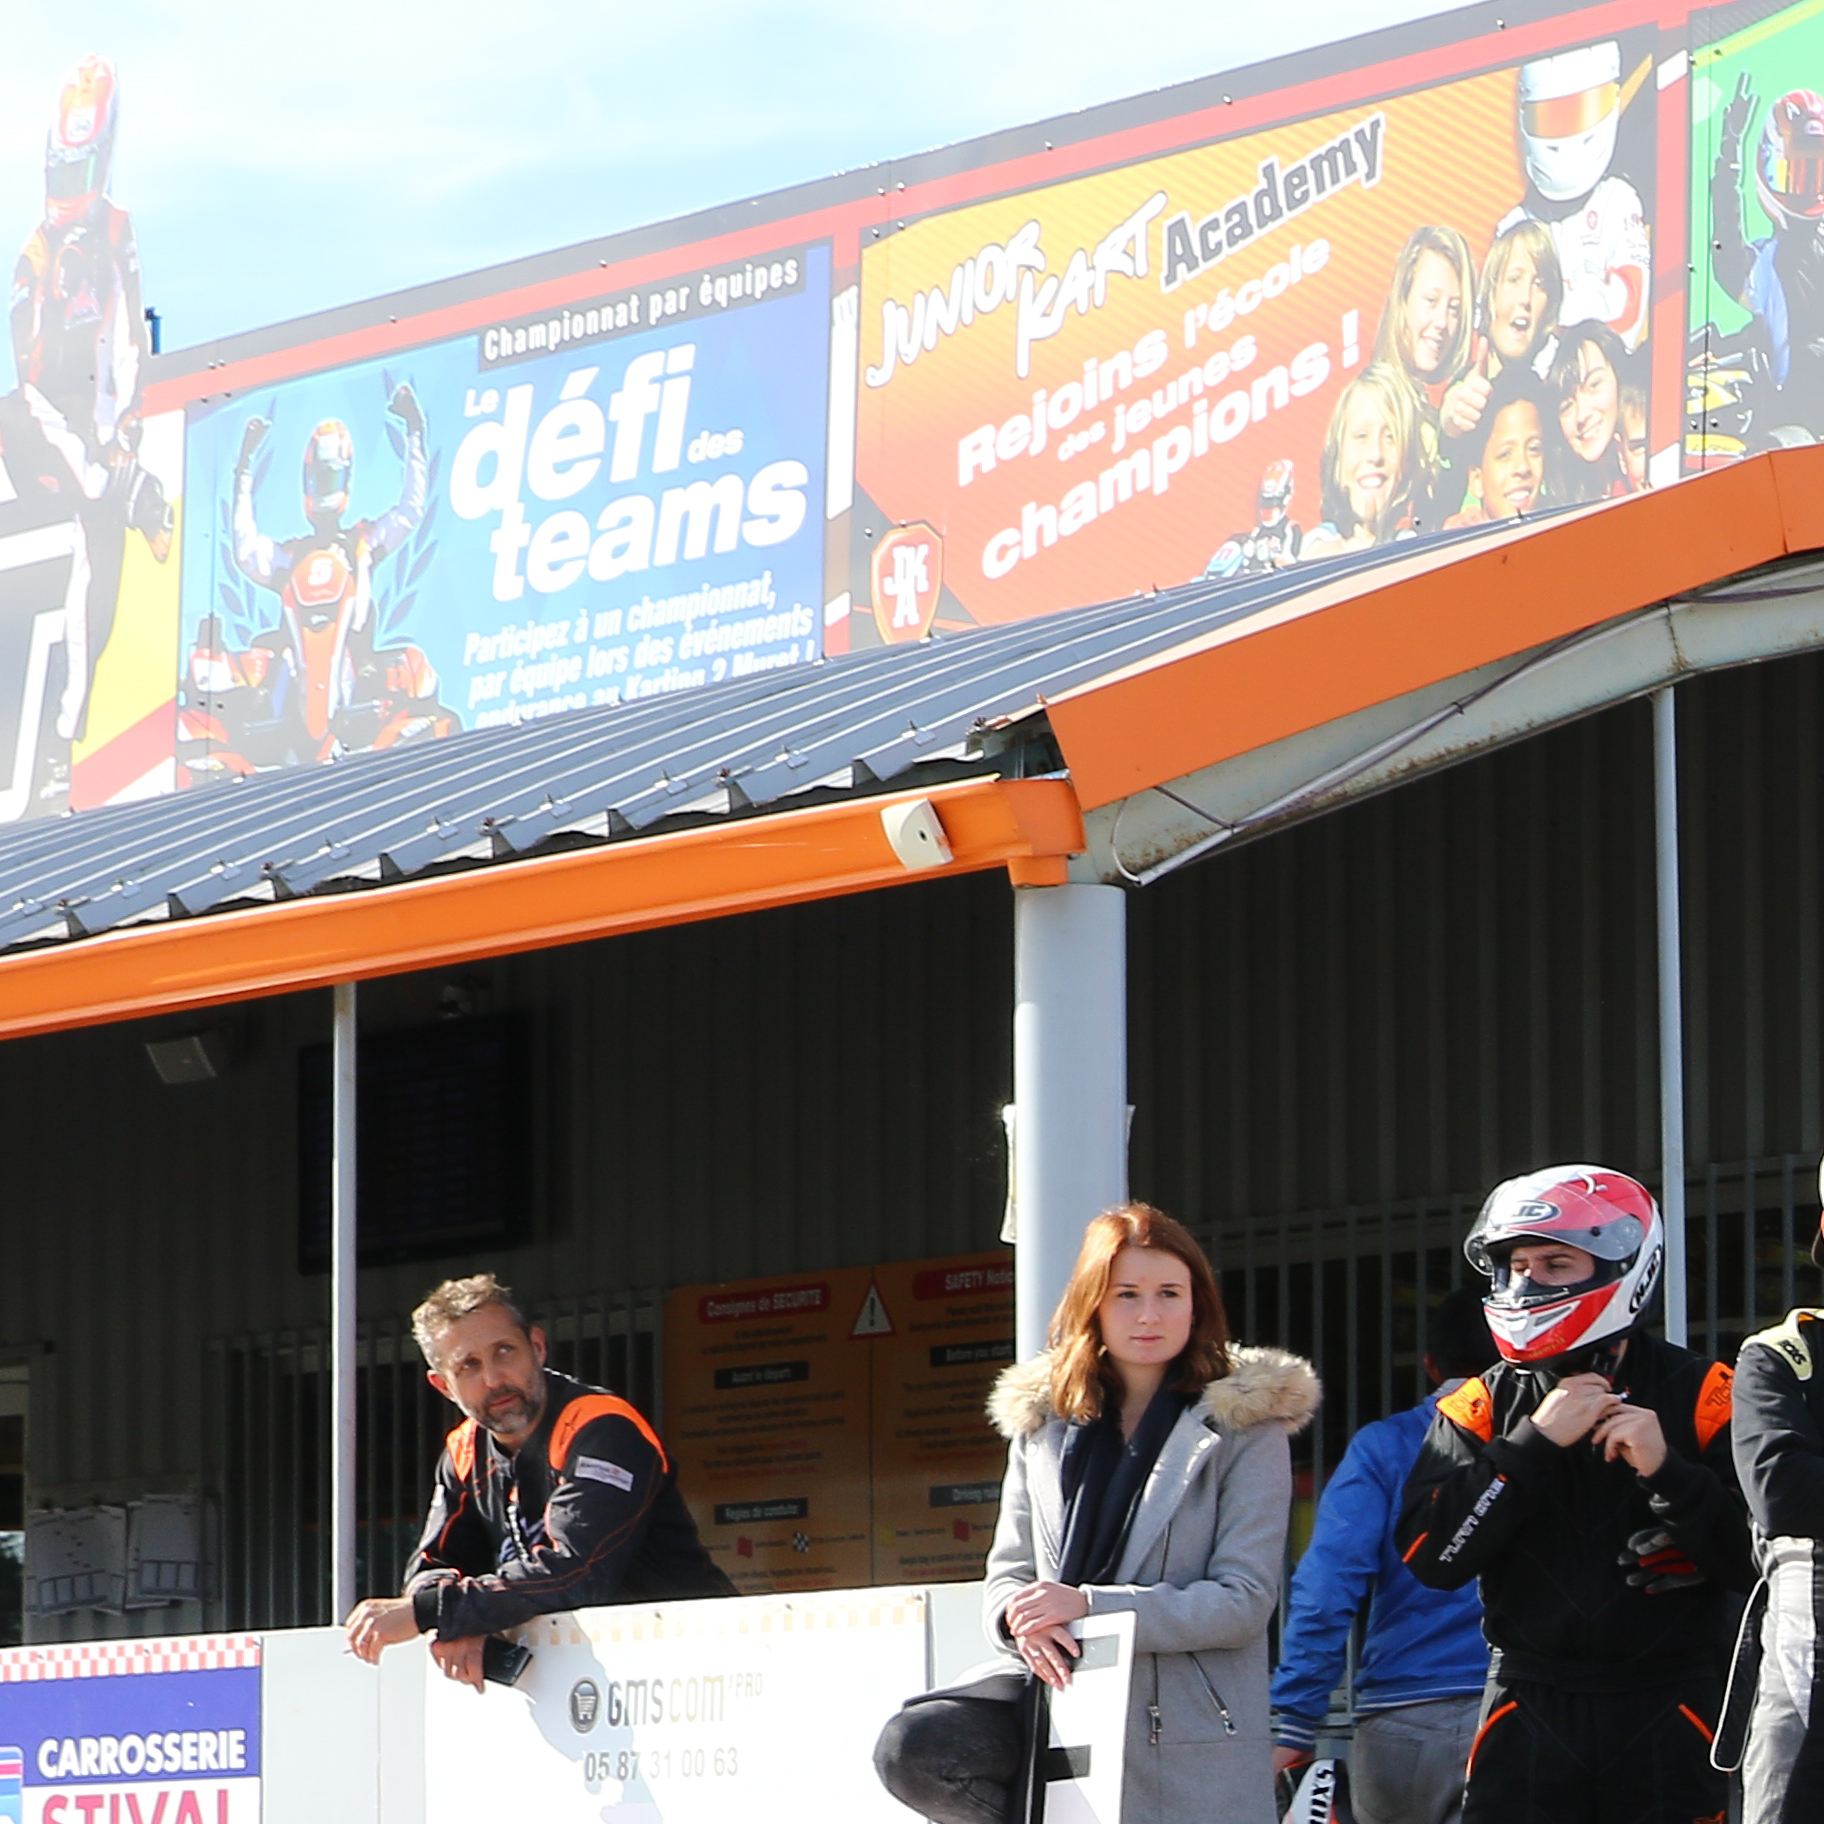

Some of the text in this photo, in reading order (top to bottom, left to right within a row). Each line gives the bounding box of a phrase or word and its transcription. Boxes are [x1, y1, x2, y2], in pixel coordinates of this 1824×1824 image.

[1163, 116, 1384, 288] Academy
[483, 258, 799, 361] Championnat par équipes
[865, 220, 1046, 388] JUNIOR
[1016, 191, 1168, 379] KART
[958, 238, 1331, 487] Rejoins l'école
[1057, 335, 1257, 461] des jeunes
[450, 343, 744, 520] Le défi des
[981, 341, 1331, 579] champions
[490, 459, 810, 602] teams
[464, 617, 570, 666] Participez
[593, 609, 623, 640] un
[468, 665, 508, 709] par
[586, 644, 630, 680] lors
[633, 634, 675, 670] des
[945, 1271, 985, 1290] SAFETY
[38, 1729, 247, 1779] CARROSSERIE
[584, 1747, 739, 1782] 05 87 31 00 63
